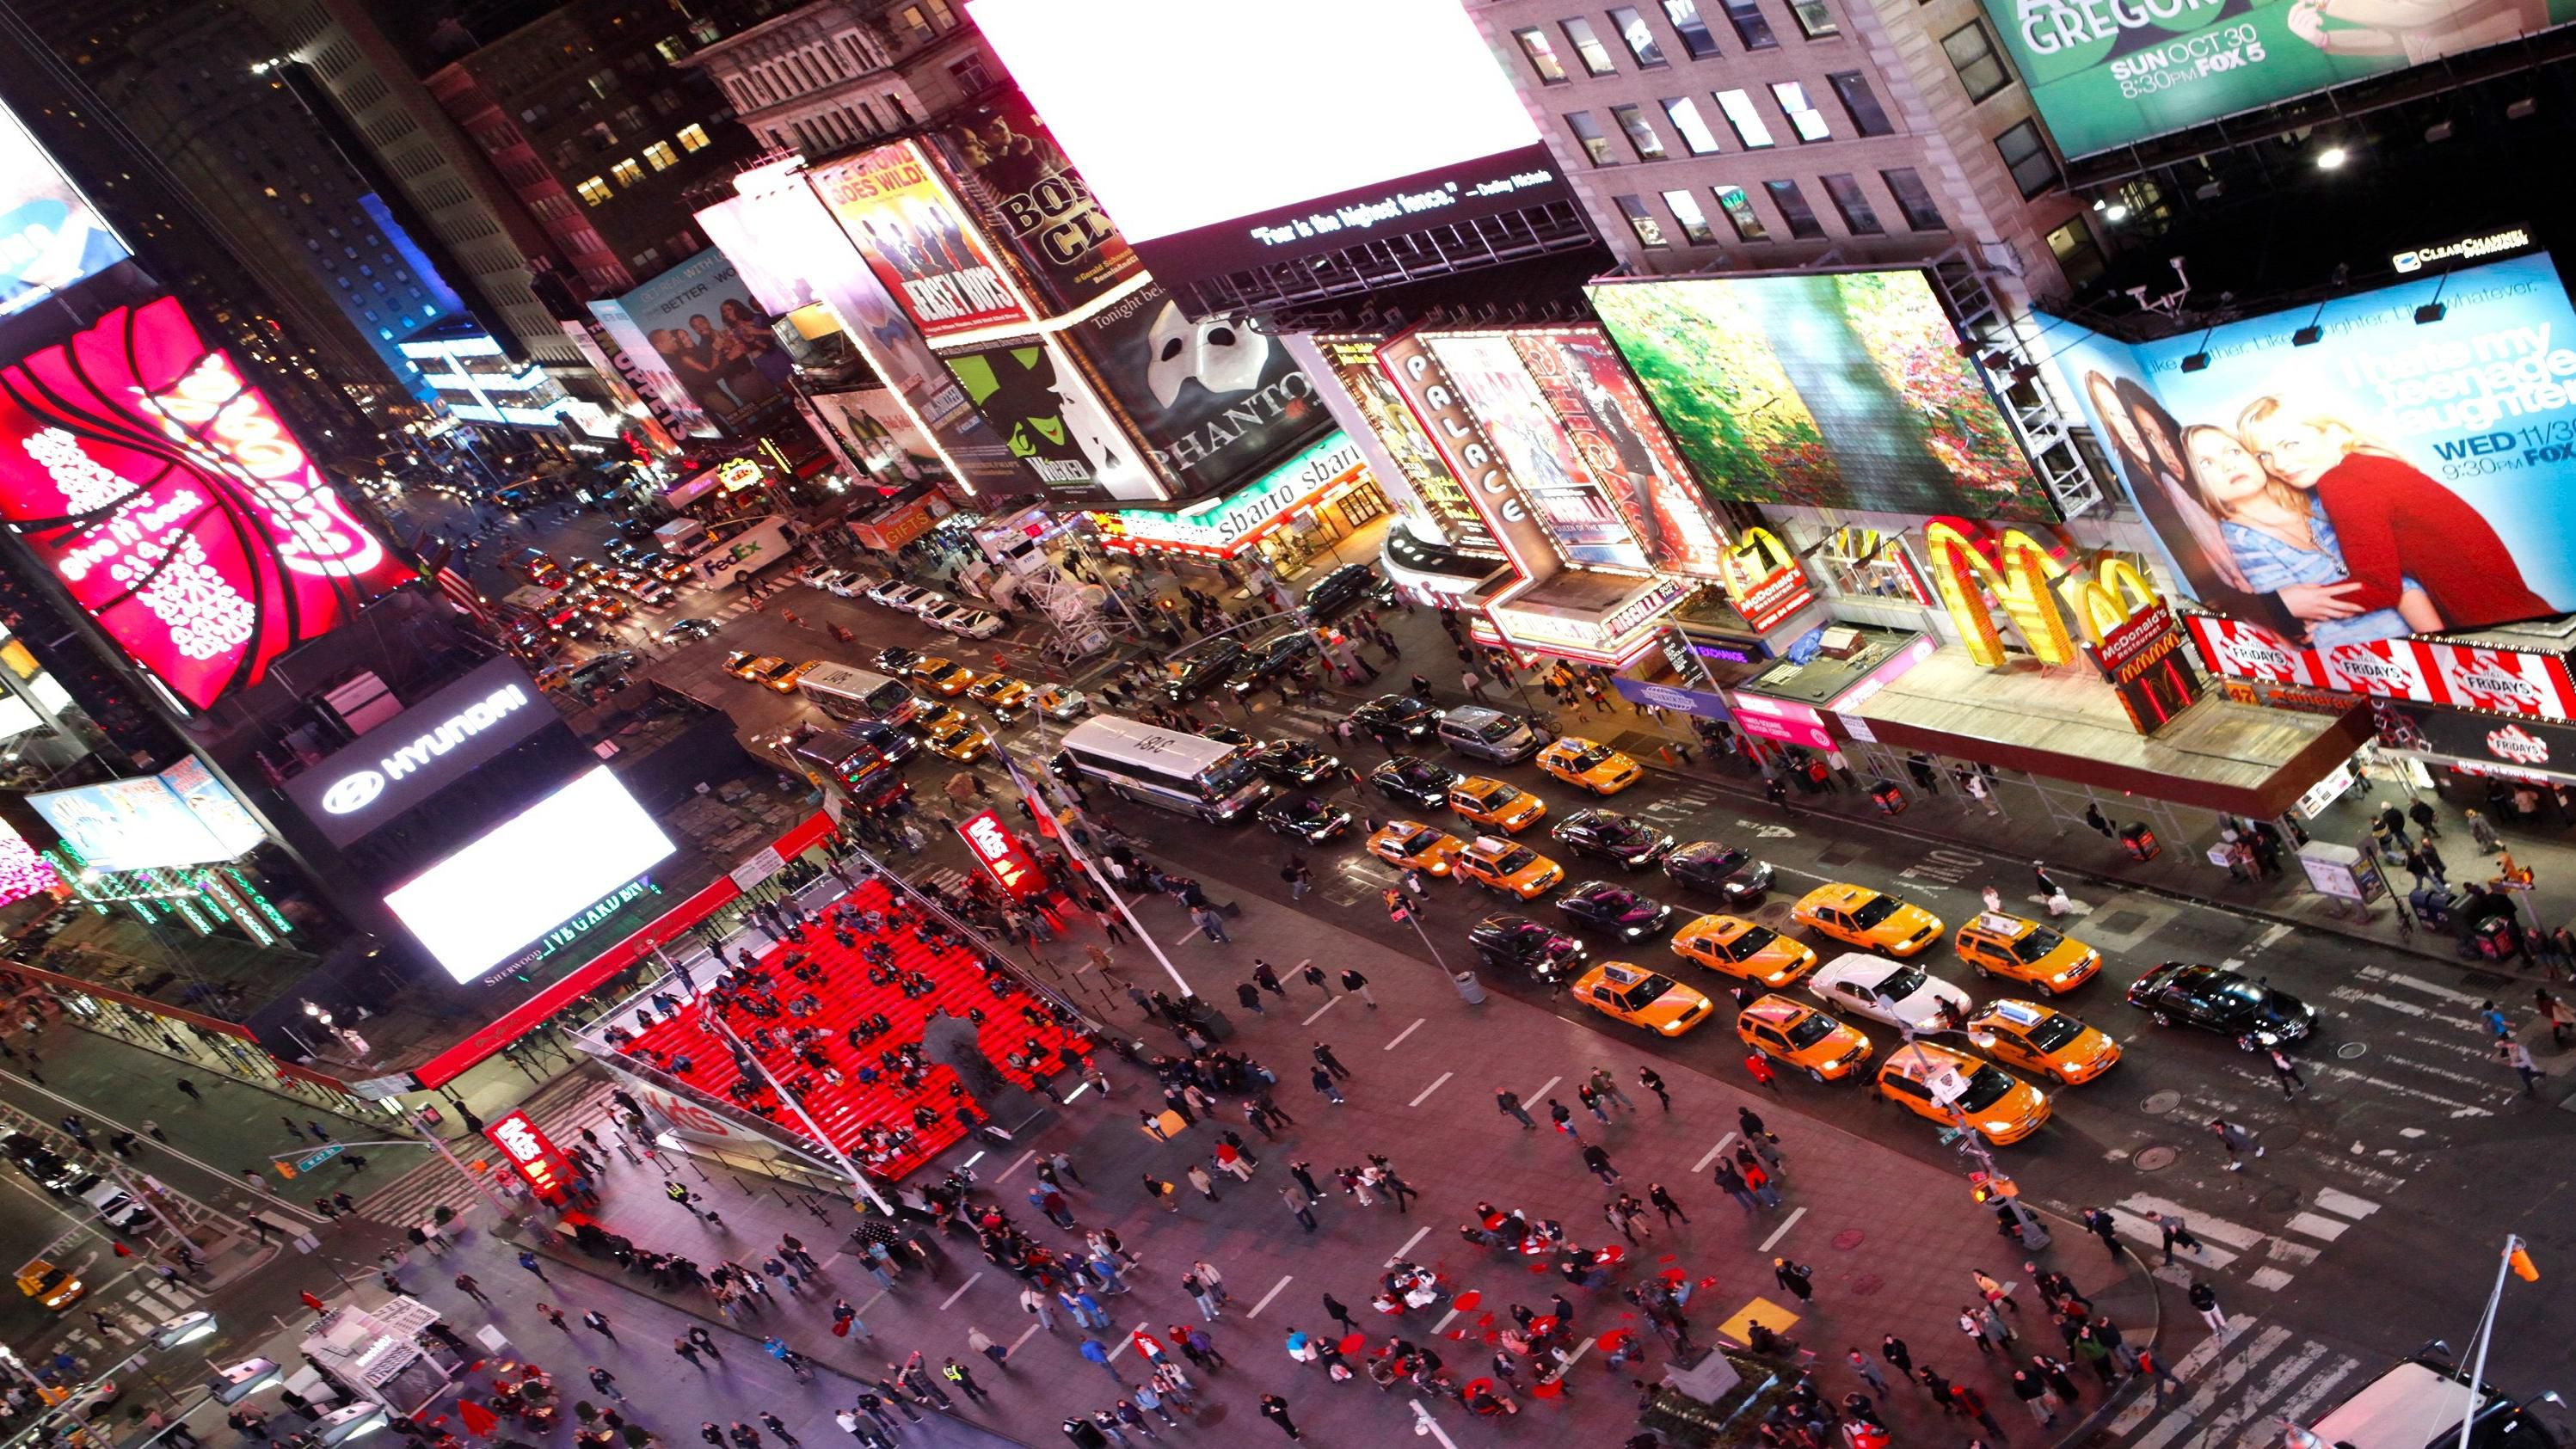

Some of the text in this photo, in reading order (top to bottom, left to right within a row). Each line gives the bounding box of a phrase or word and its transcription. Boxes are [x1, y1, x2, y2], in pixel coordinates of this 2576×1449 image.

[2110, 23, 2257, 80] SUN OCT 30
[2120, 41, 2266, 100] 8:30PM FOX 5
[831, 163, 928, 206] GOES WILD!
[1293, 219, 1314, 237] is
[1309, 214, 1342, 234] the
[1336, 198, 1403, 228] highest
[661, 283, 710, 314] BETTER
[901, 265, 1017, 322] JERSEY BOYS
[2444, 281, 2538, 316] whatever.
[1091, 298, 1141, 331] Tonight
[2471, 322, 2551, 361] my
[1146, 371, 1314, 471] PHANTO
[1407, 355, 1526, 523] PALACE
[2432, 432, 2517, 461] WED
[2442, 457, 2522, 480] 9:30PM
[886, 513, 929, 544] GIFTS
[1219, 484, 1295, 542] sbarro
[703, 538, 762, 578] FedEx
[1740, 568, 1801, 612] McDonald's
[1755, 582, 1794, 611] Restaurant
[1605, 591, 1665, 640] PRISCILLA
[2101, 608, 2167, 661] McDonald's
[2117, 625, 2161, 660] Restaurant
[2230, 686, 2254, 703] 47
[380, 684, 528, 781] HYUNDAI
[969, 816, 1009, 859] tkts
[483, 949, 543, 987] SHERWOOD
[496, 1117, 543, 1161] tkts
